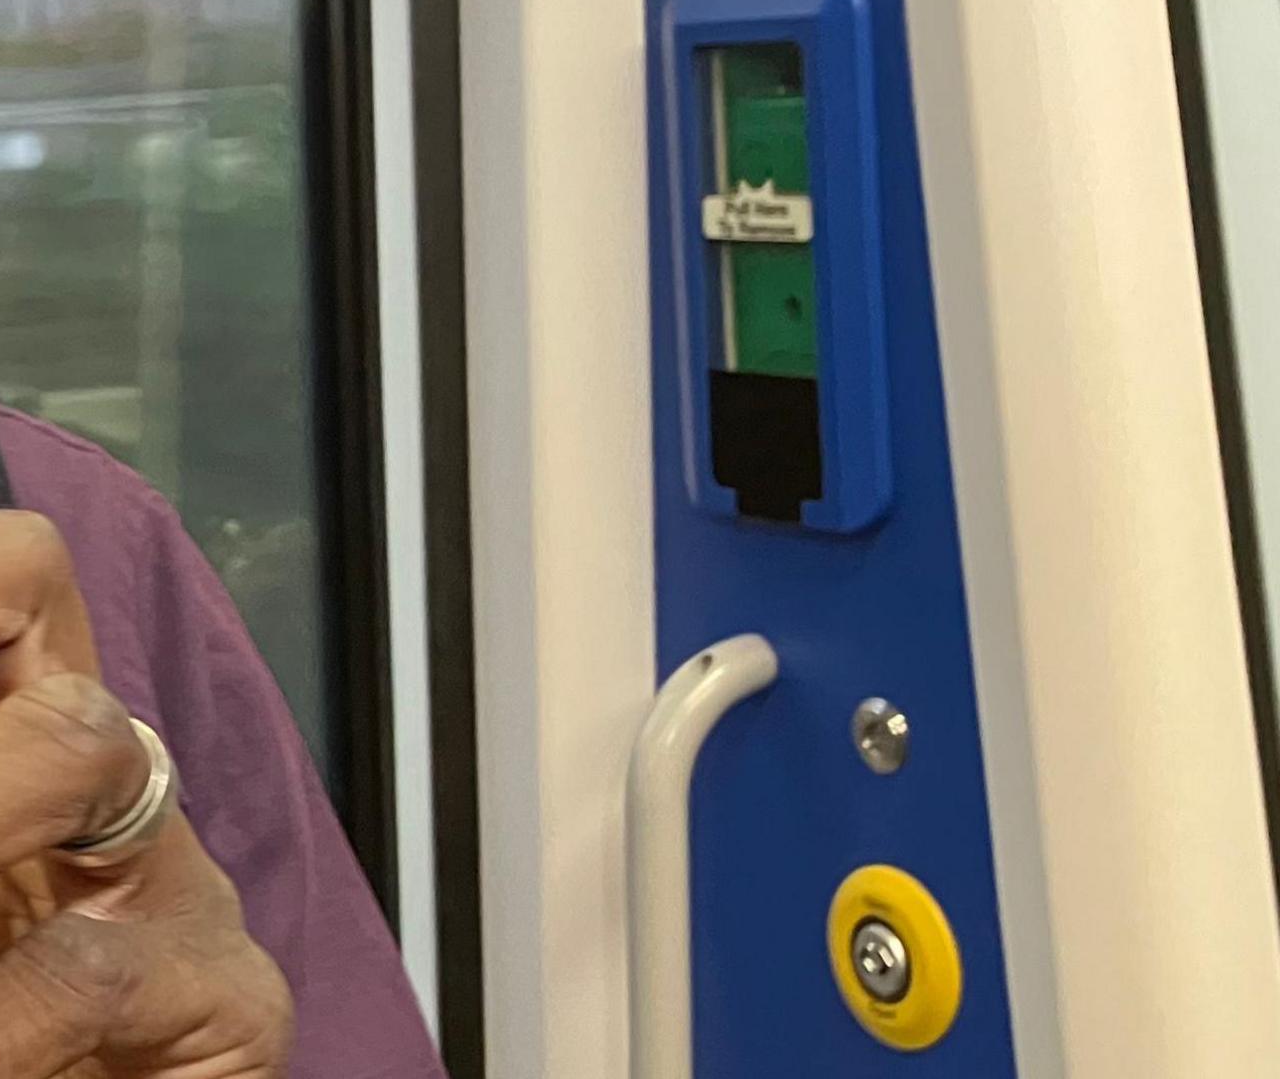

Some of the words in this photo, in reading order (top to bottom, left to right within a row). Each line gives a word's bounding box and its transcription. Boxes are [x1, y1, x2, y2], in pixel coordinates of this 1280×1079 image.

[725, 202, 749, 216] Pull
[754, 203, 788, 217] Here
[739, 221, 795, 237] Remove
